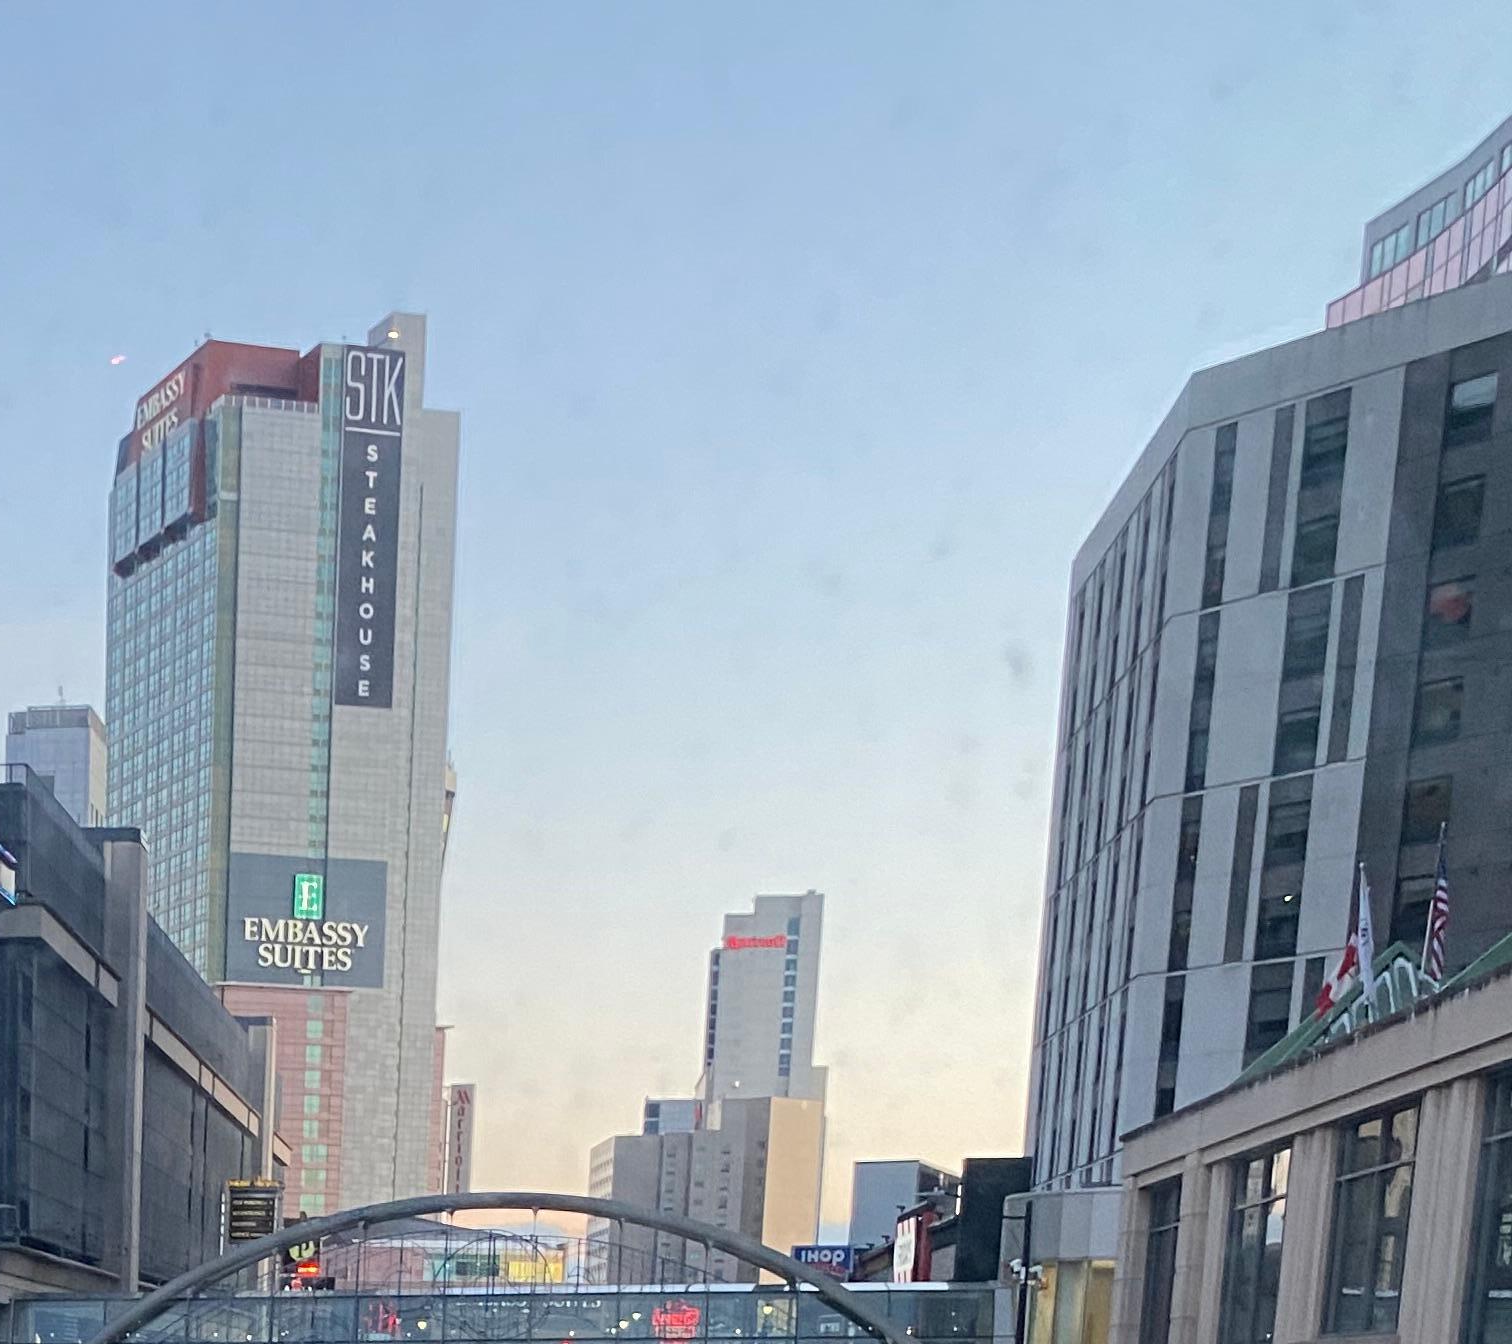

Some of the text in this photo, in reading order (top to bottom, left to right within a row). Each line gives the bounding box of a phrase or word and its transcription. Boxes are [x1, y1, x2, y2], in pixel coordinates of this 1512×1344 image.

[137, 370, 186, 430] EMBASSY
[345, 350, 404, 426] STK
[357, 444, 379, 698] STEAKHOUSE
[244, 917, 368, 948] EMBASSY
[258, 943, 352, 971] SUITES
